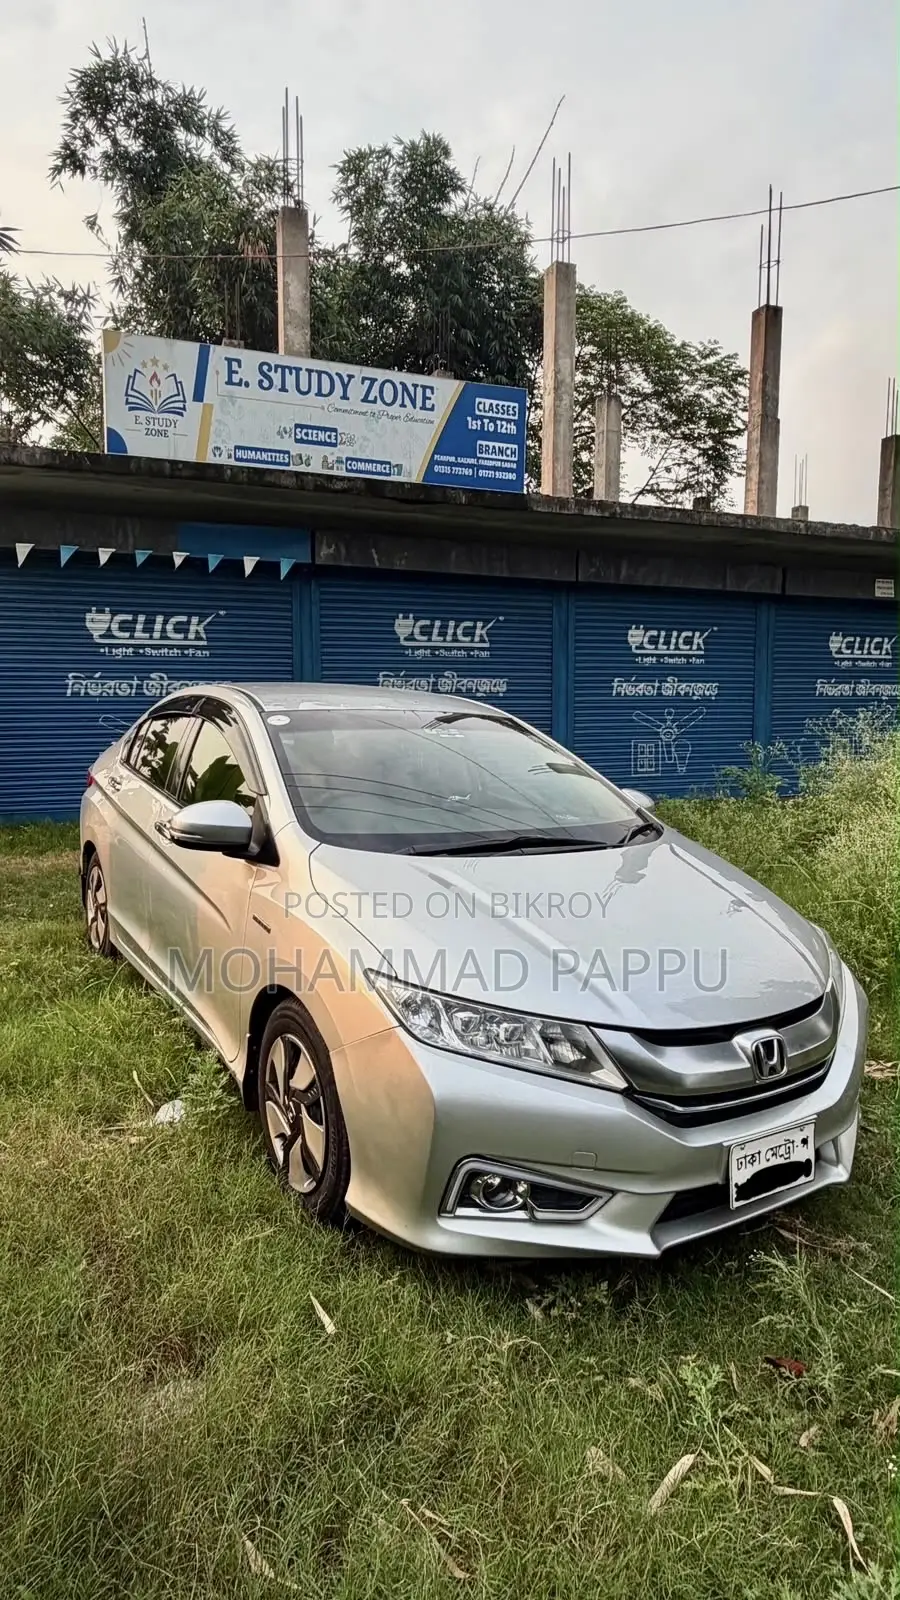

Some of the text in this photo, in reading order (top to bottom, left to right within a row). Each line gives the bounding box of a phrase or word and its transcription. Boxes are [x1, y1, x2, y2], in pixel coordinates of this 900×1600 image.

[223, 356, 435, 412] E. STUDY ZONE
[476, 401, 517, 417] CLASSES
[135, 415, 178, 429] E. STUDY
[467, 416, 517, 435] 1st To 12th
[145, 427, 169, 438] ZONE
[295, 428, 337, 443] SCIENCE
[235, 448, 289, 463] HUMANITIES
[478, 444, 517, 459] BRANCH
[346, 462, 391, 474] COMMERCE
[110, 613, 216, 640] CLICK
[414, 617, 497, 643] CLICK
[643, 628, 712, 650] CLICK
[841, 635, 897, 655] CLICK
[736, 1150, 761, 1170] ঢাকা
